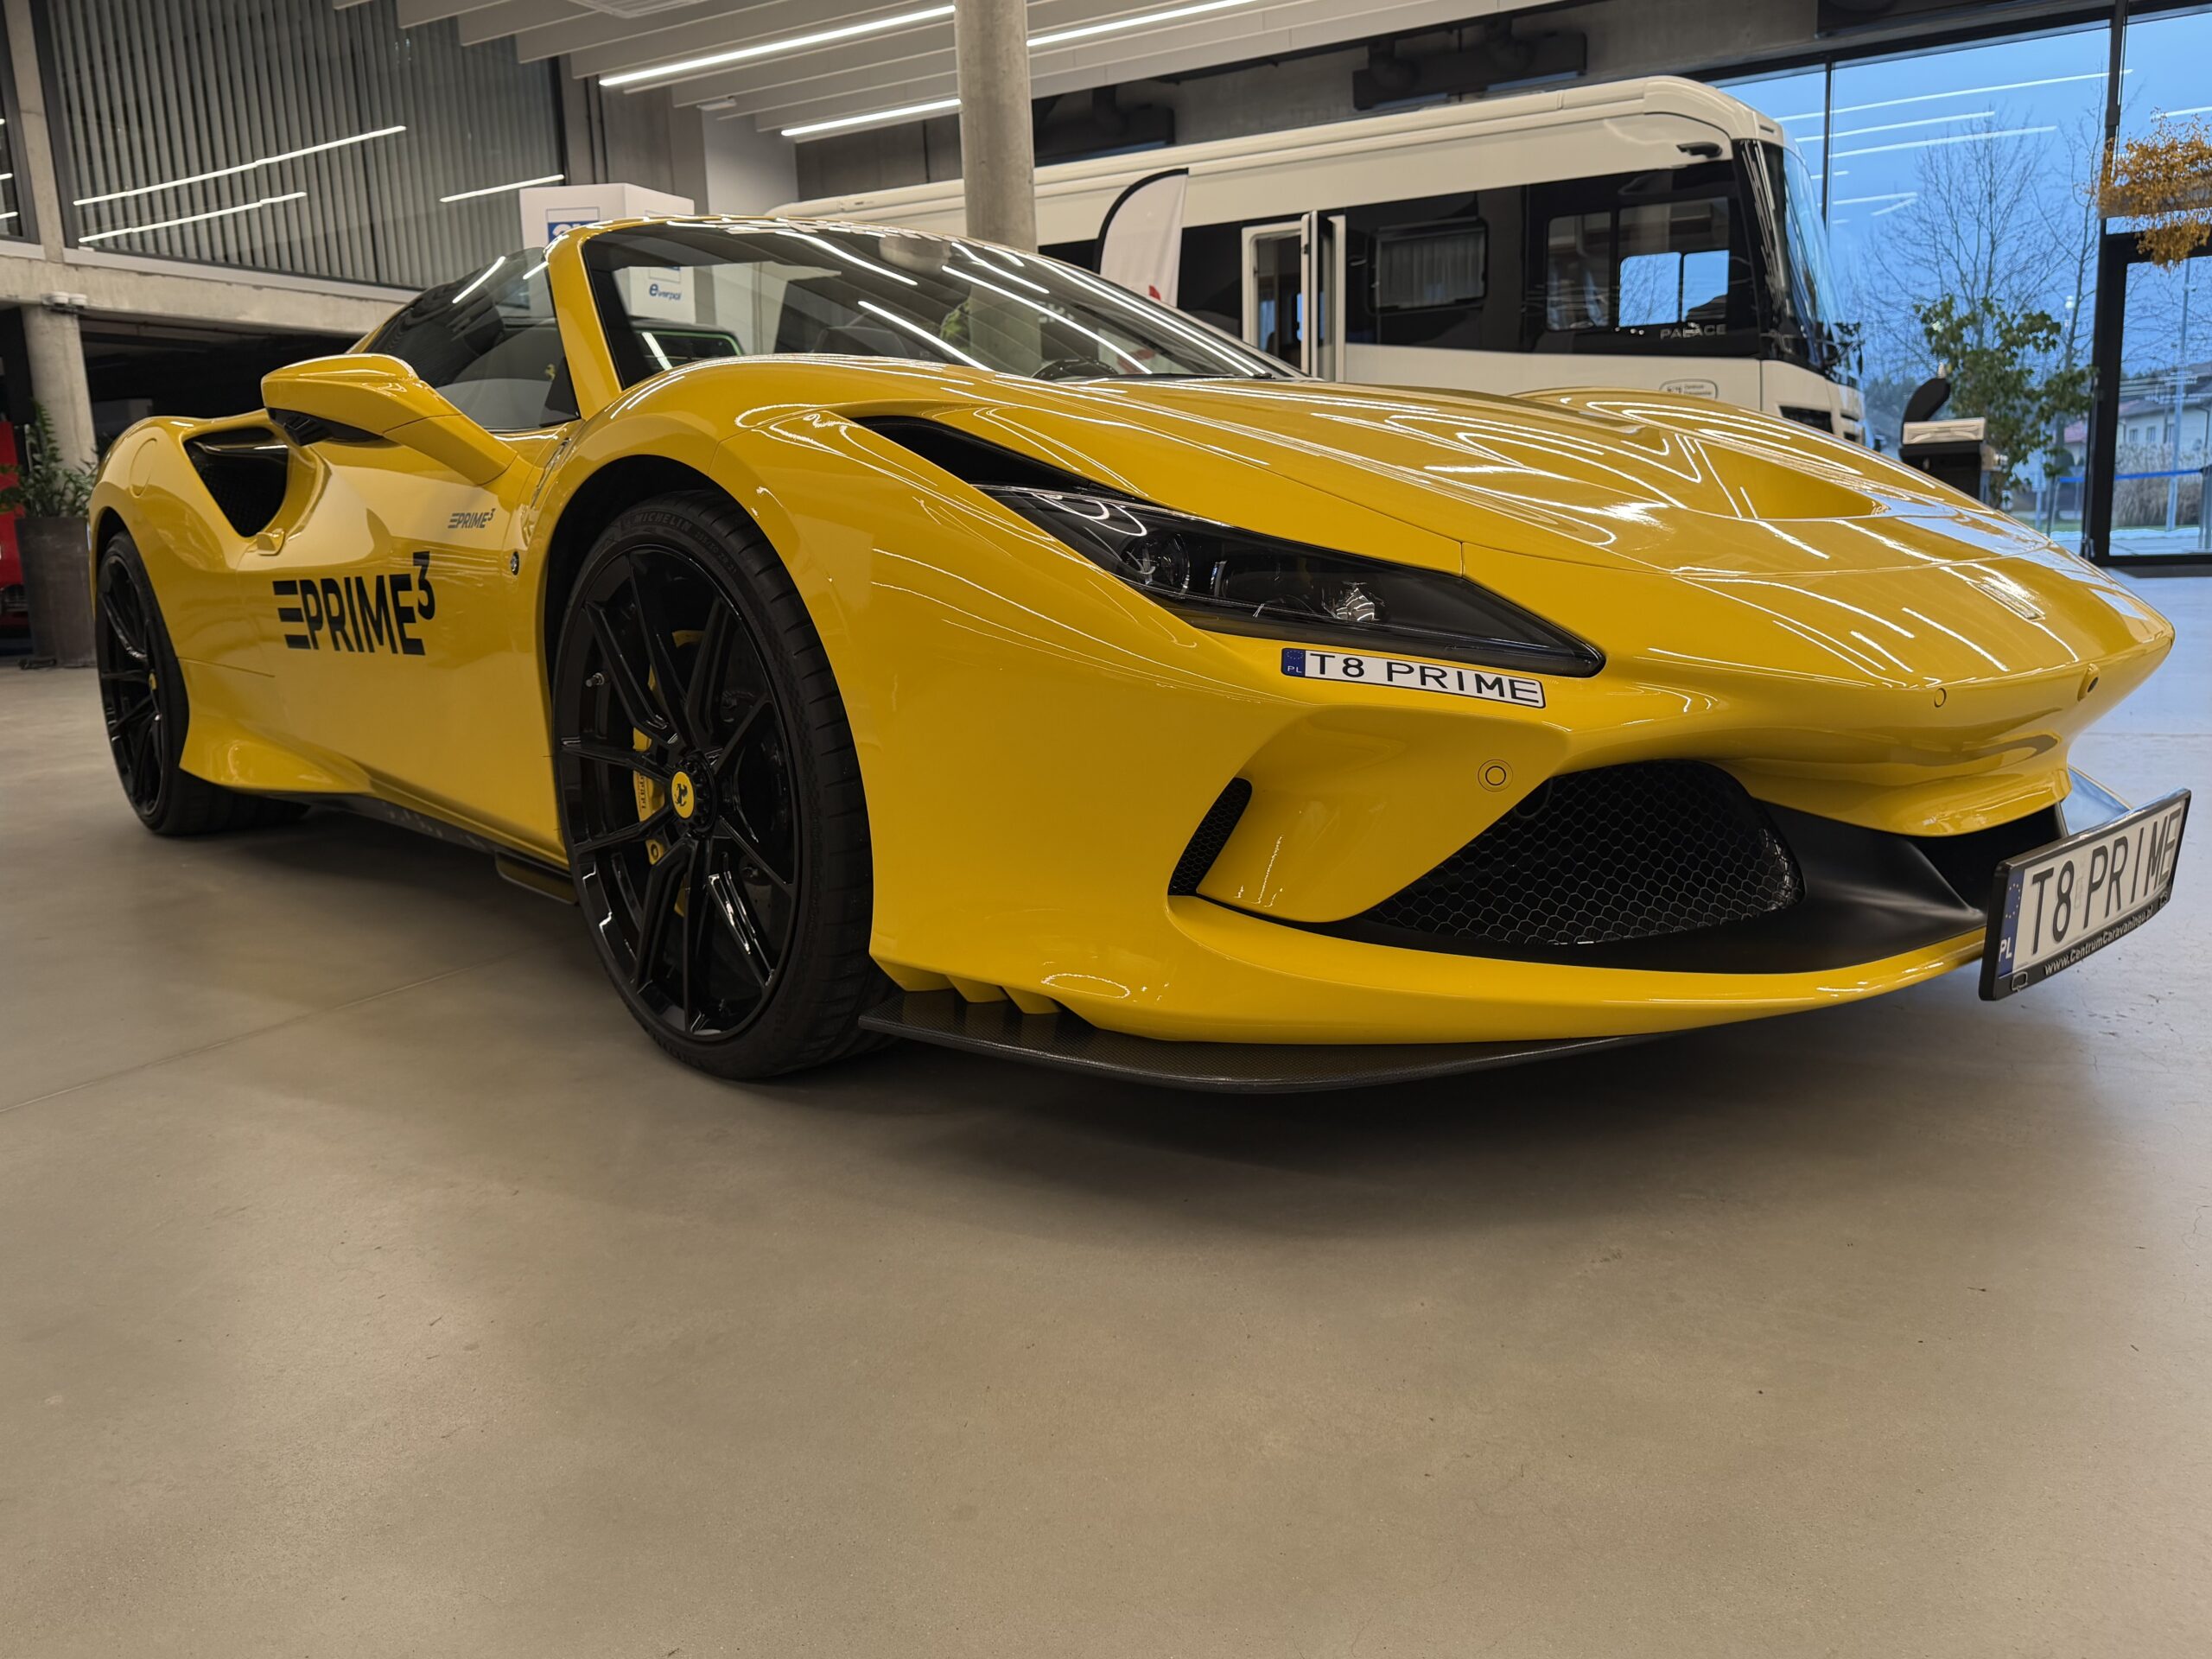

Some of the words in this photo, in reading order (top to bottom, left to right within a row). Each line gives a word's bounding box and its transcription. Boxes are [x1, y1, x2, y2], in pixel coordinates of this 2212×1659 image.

[636, 512, 693, 531] MICHELIN
[1287, 664, 1302, 674] PL
[1309, 652, 1365, 678] T8
[1386, 661, 1539, 704] PRIME
[2031, 859, 2075, 955] T8
[2083, 807, 2183, 930] PRIME
[1999, 938, 2012, 963] PL
